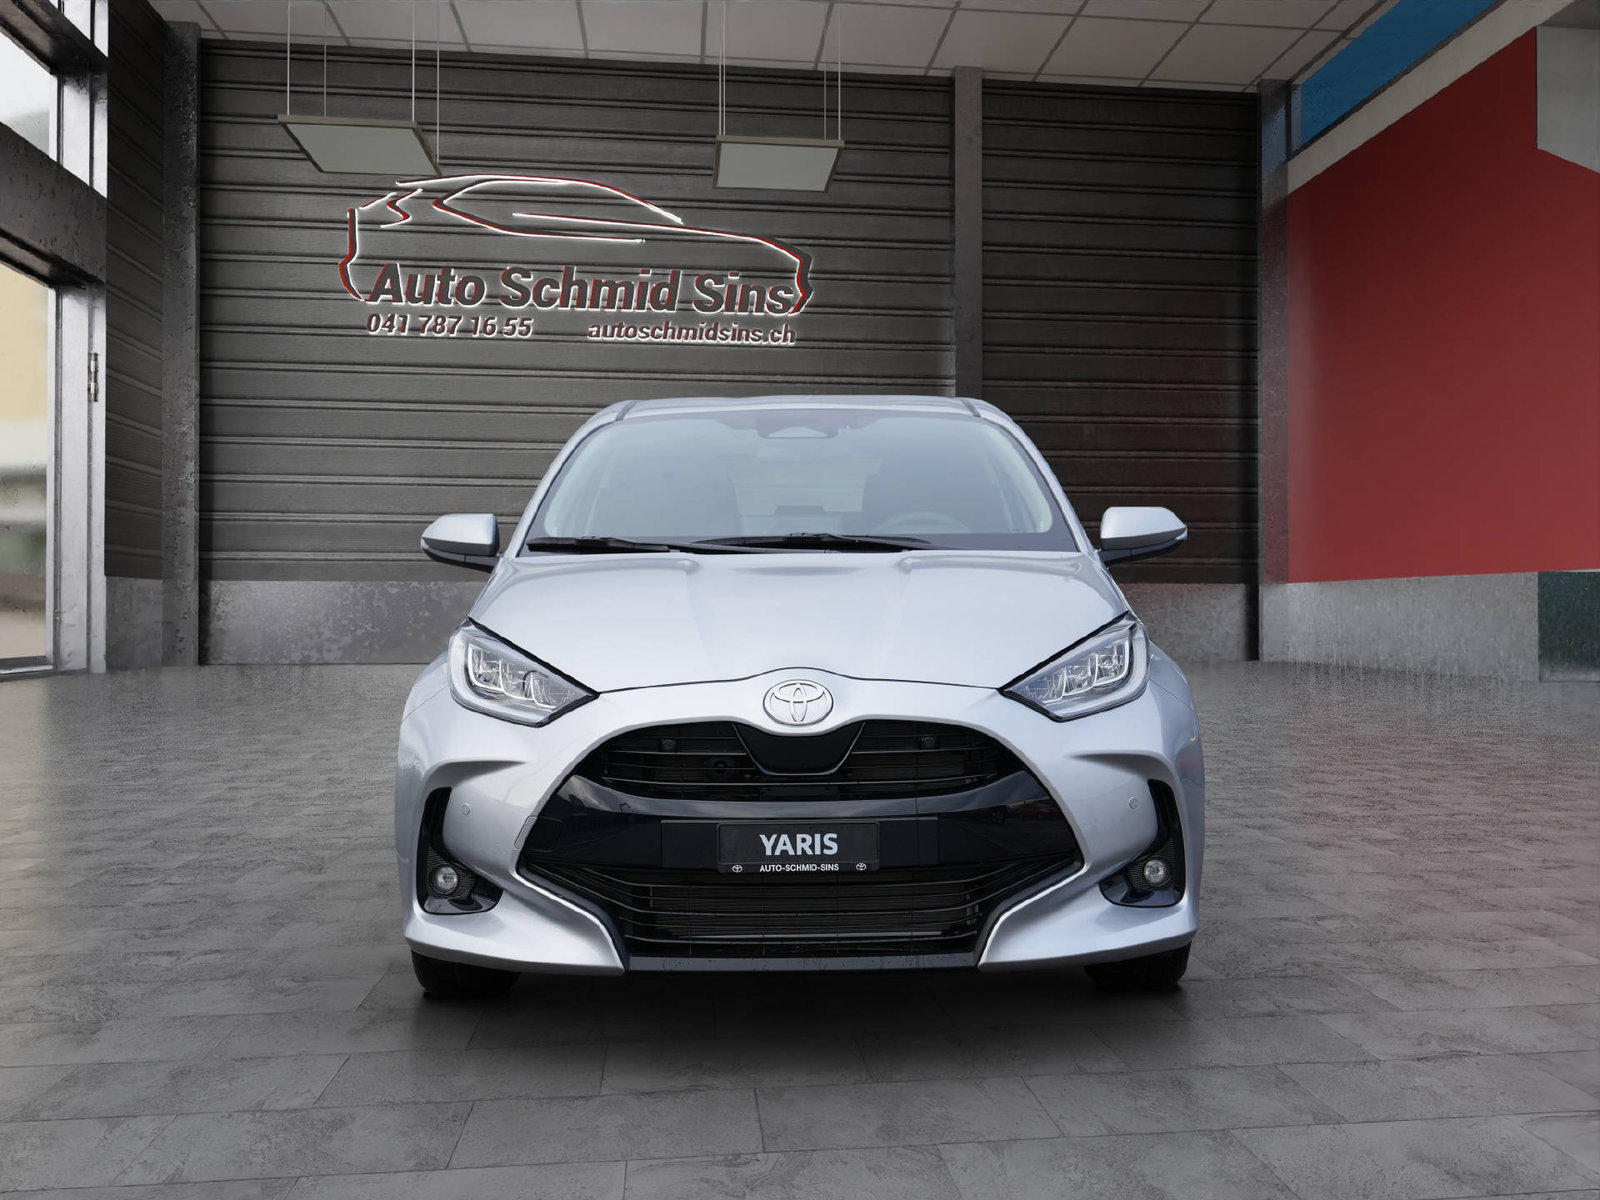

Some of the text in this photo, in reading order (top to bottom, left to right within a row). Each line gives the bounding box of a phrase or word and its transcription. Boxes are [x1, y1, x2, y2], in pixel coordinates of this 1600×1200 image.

[366, 262, 794, 315] Auto Schmid Sins
[366, 313, 534, 338] 041 787 16 55
[586, 320, 797, 345] autoschmidsins.ch
[759, 833, 839, 856] YARIS
[759, 863, 840, 873] AUTO-SCHMID-SINS
